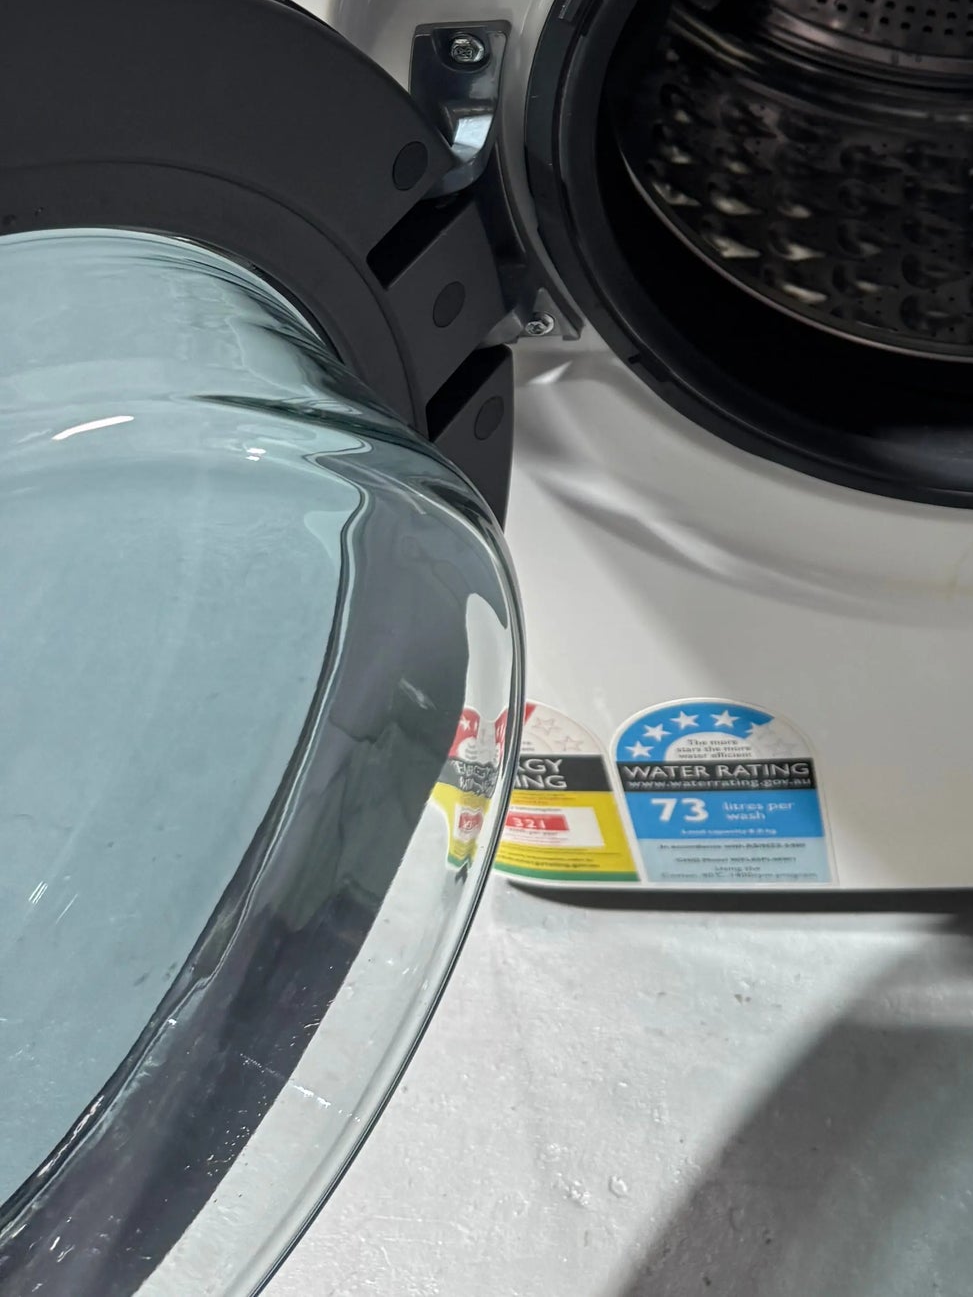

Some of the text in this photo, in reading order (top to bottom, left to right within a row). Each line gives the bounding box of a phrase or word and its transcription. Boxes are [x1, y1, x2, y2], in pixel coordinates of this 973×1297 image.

[624, 762, 810, 779] WATER RATING
[629, 777, 811, 790] www.waterrating.gov.au
[651, 797, 710, 823] 73
[722, 801, 796, 812] litres per
[725, 810, 766, 821] wash
